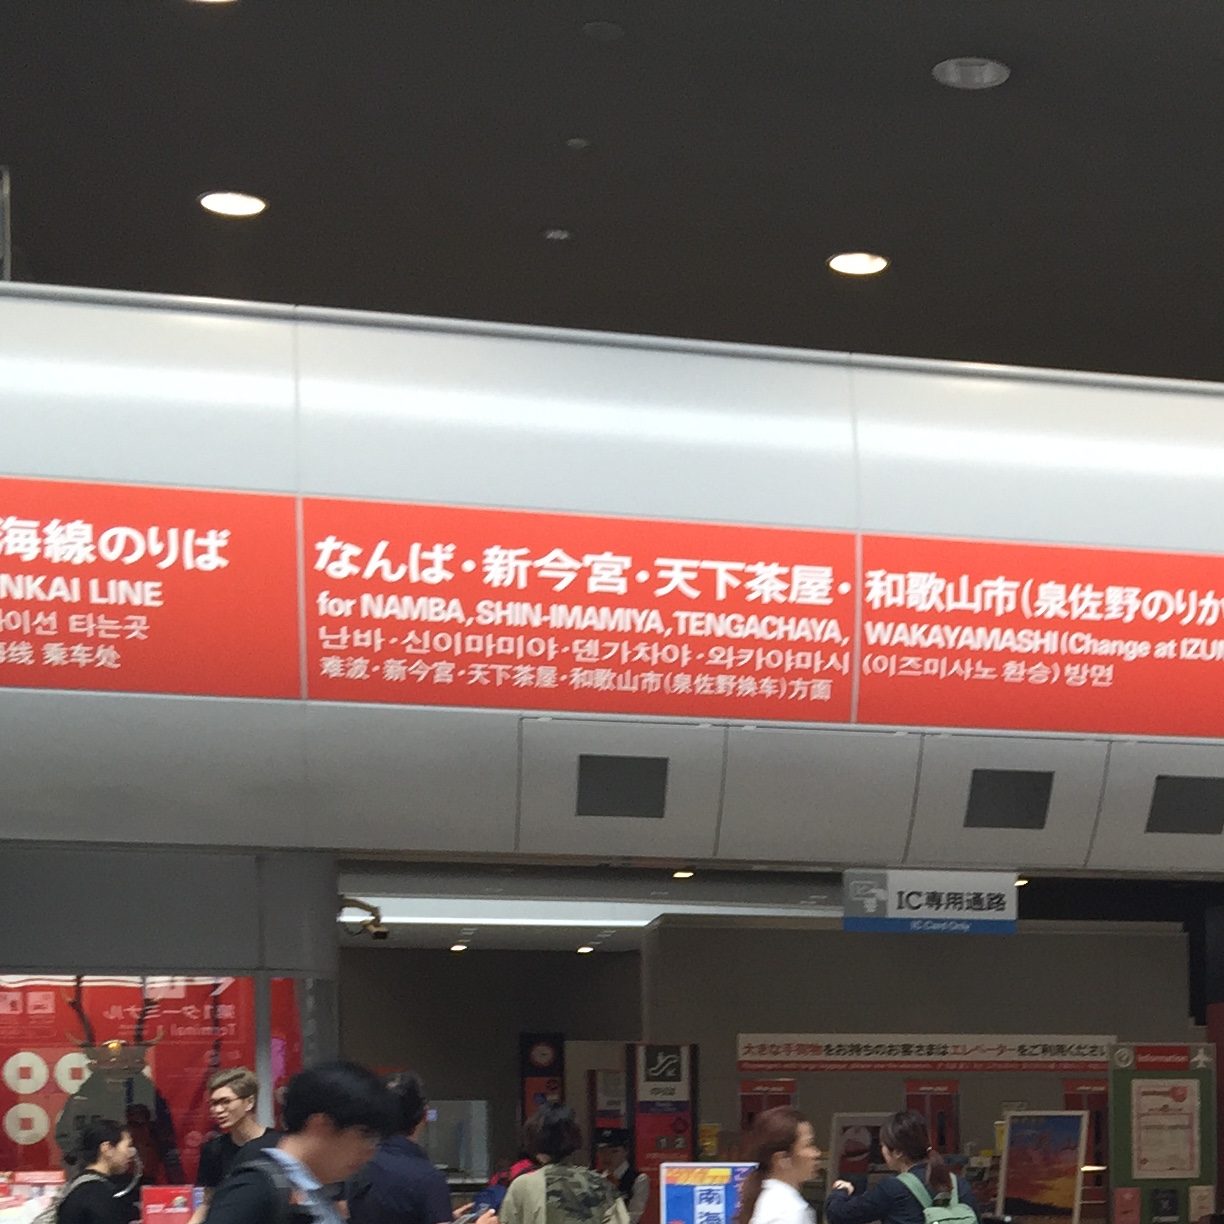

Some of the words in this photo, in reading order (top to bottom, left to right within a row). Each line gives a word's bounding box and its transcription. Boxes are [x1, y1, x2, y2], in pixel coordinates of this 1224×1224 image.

[0, 516, 231, 571] 海線のりば
[89, 578, 163, 607] LINE
[316, 590, 356, 619] for
[673, 610, 850, 647] TENGACHAYA,
[1154, 642, 1177, 659] at
